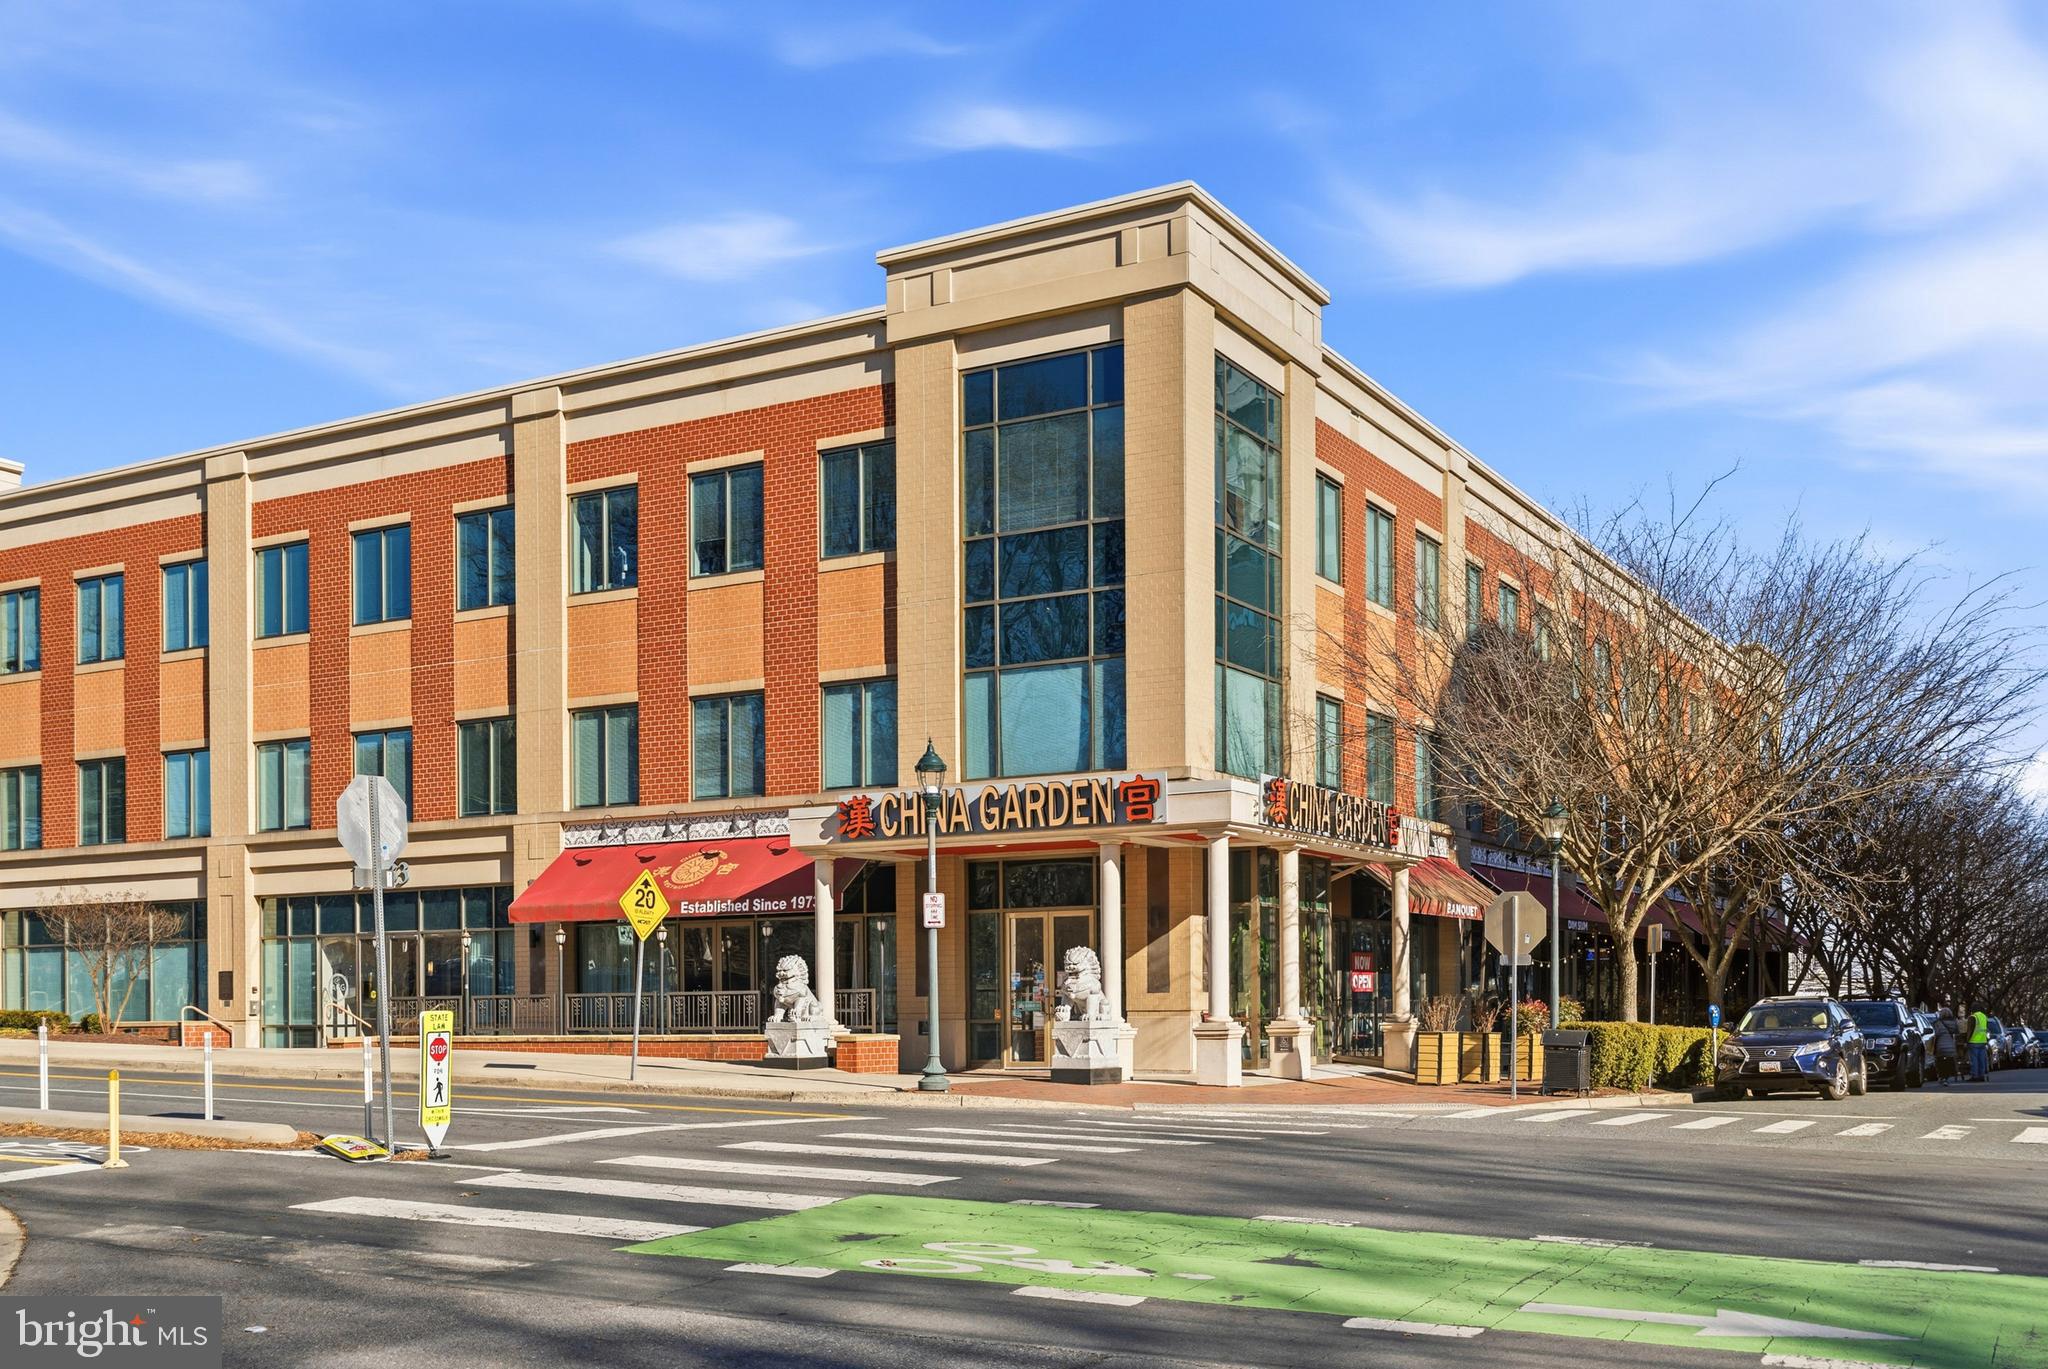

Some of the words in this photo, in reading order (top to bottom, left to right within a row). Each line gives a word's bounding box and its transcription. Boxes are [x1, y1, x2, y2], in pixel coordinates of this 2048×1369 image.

[881, 788, 972, 837] CHINA
[979, 778, 1114, 831] GARDEN
[1119, 774, 1160, 821] 宮
[1268, 777, 1288, 824] 漢
[837, 795, 876, 838] 漢
[1290, 781, 1331, 833] CHINA
[1336, 792, 1387, 843] GARDEN
[635, 888, 656, 909] 20
[680, 899, 749, 913] Established
[752, 898, 787, 911] Since
[1447, 902, 1478, 917] BANQUET
[1354, 956, 1371, 970] NOW
[1353, 974, 1372, 989] OPEN
[430, 1045, 447, 1055] STOP
